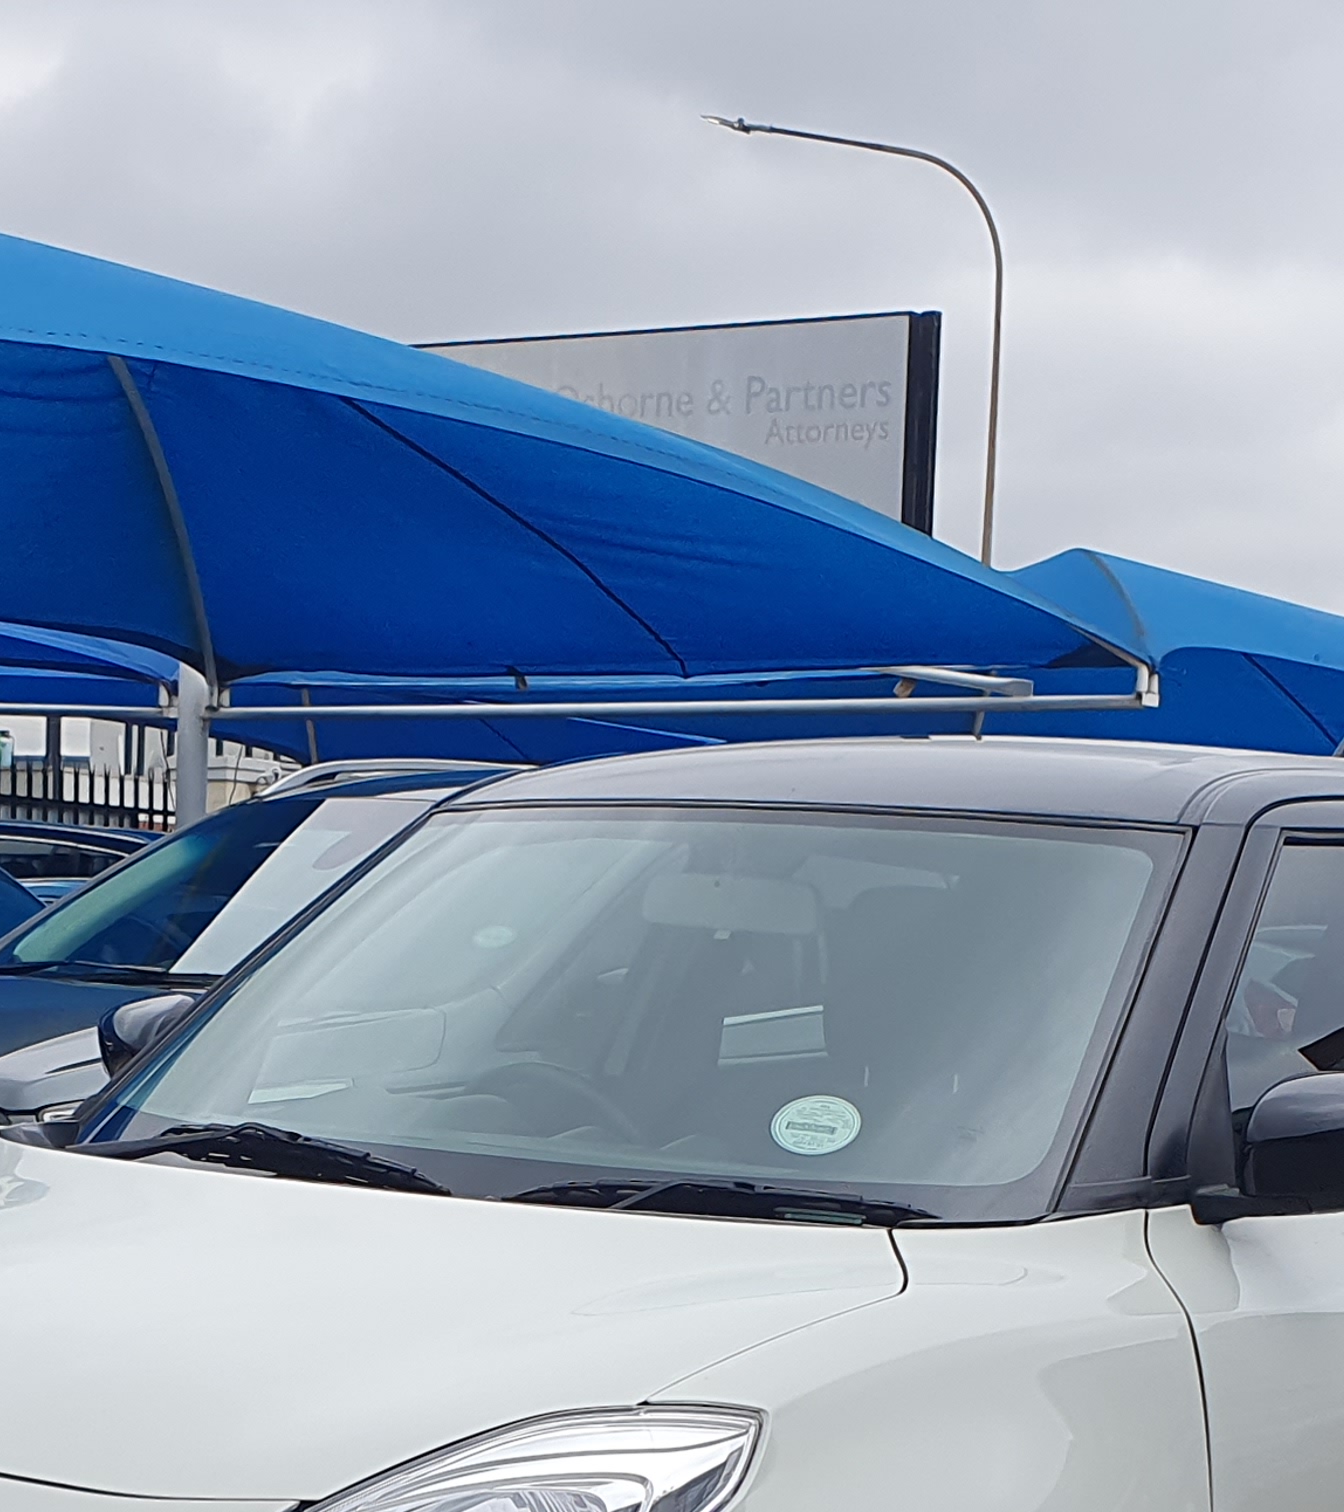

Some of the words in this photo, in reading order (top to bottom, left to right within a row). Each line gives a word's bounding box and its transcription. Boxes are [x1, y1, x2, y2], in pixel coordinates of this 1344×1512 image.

[708, 379, 731, 416] &
[745, 375, 892, 414] Partners
[764, 418, 890, 449] Attorneys
